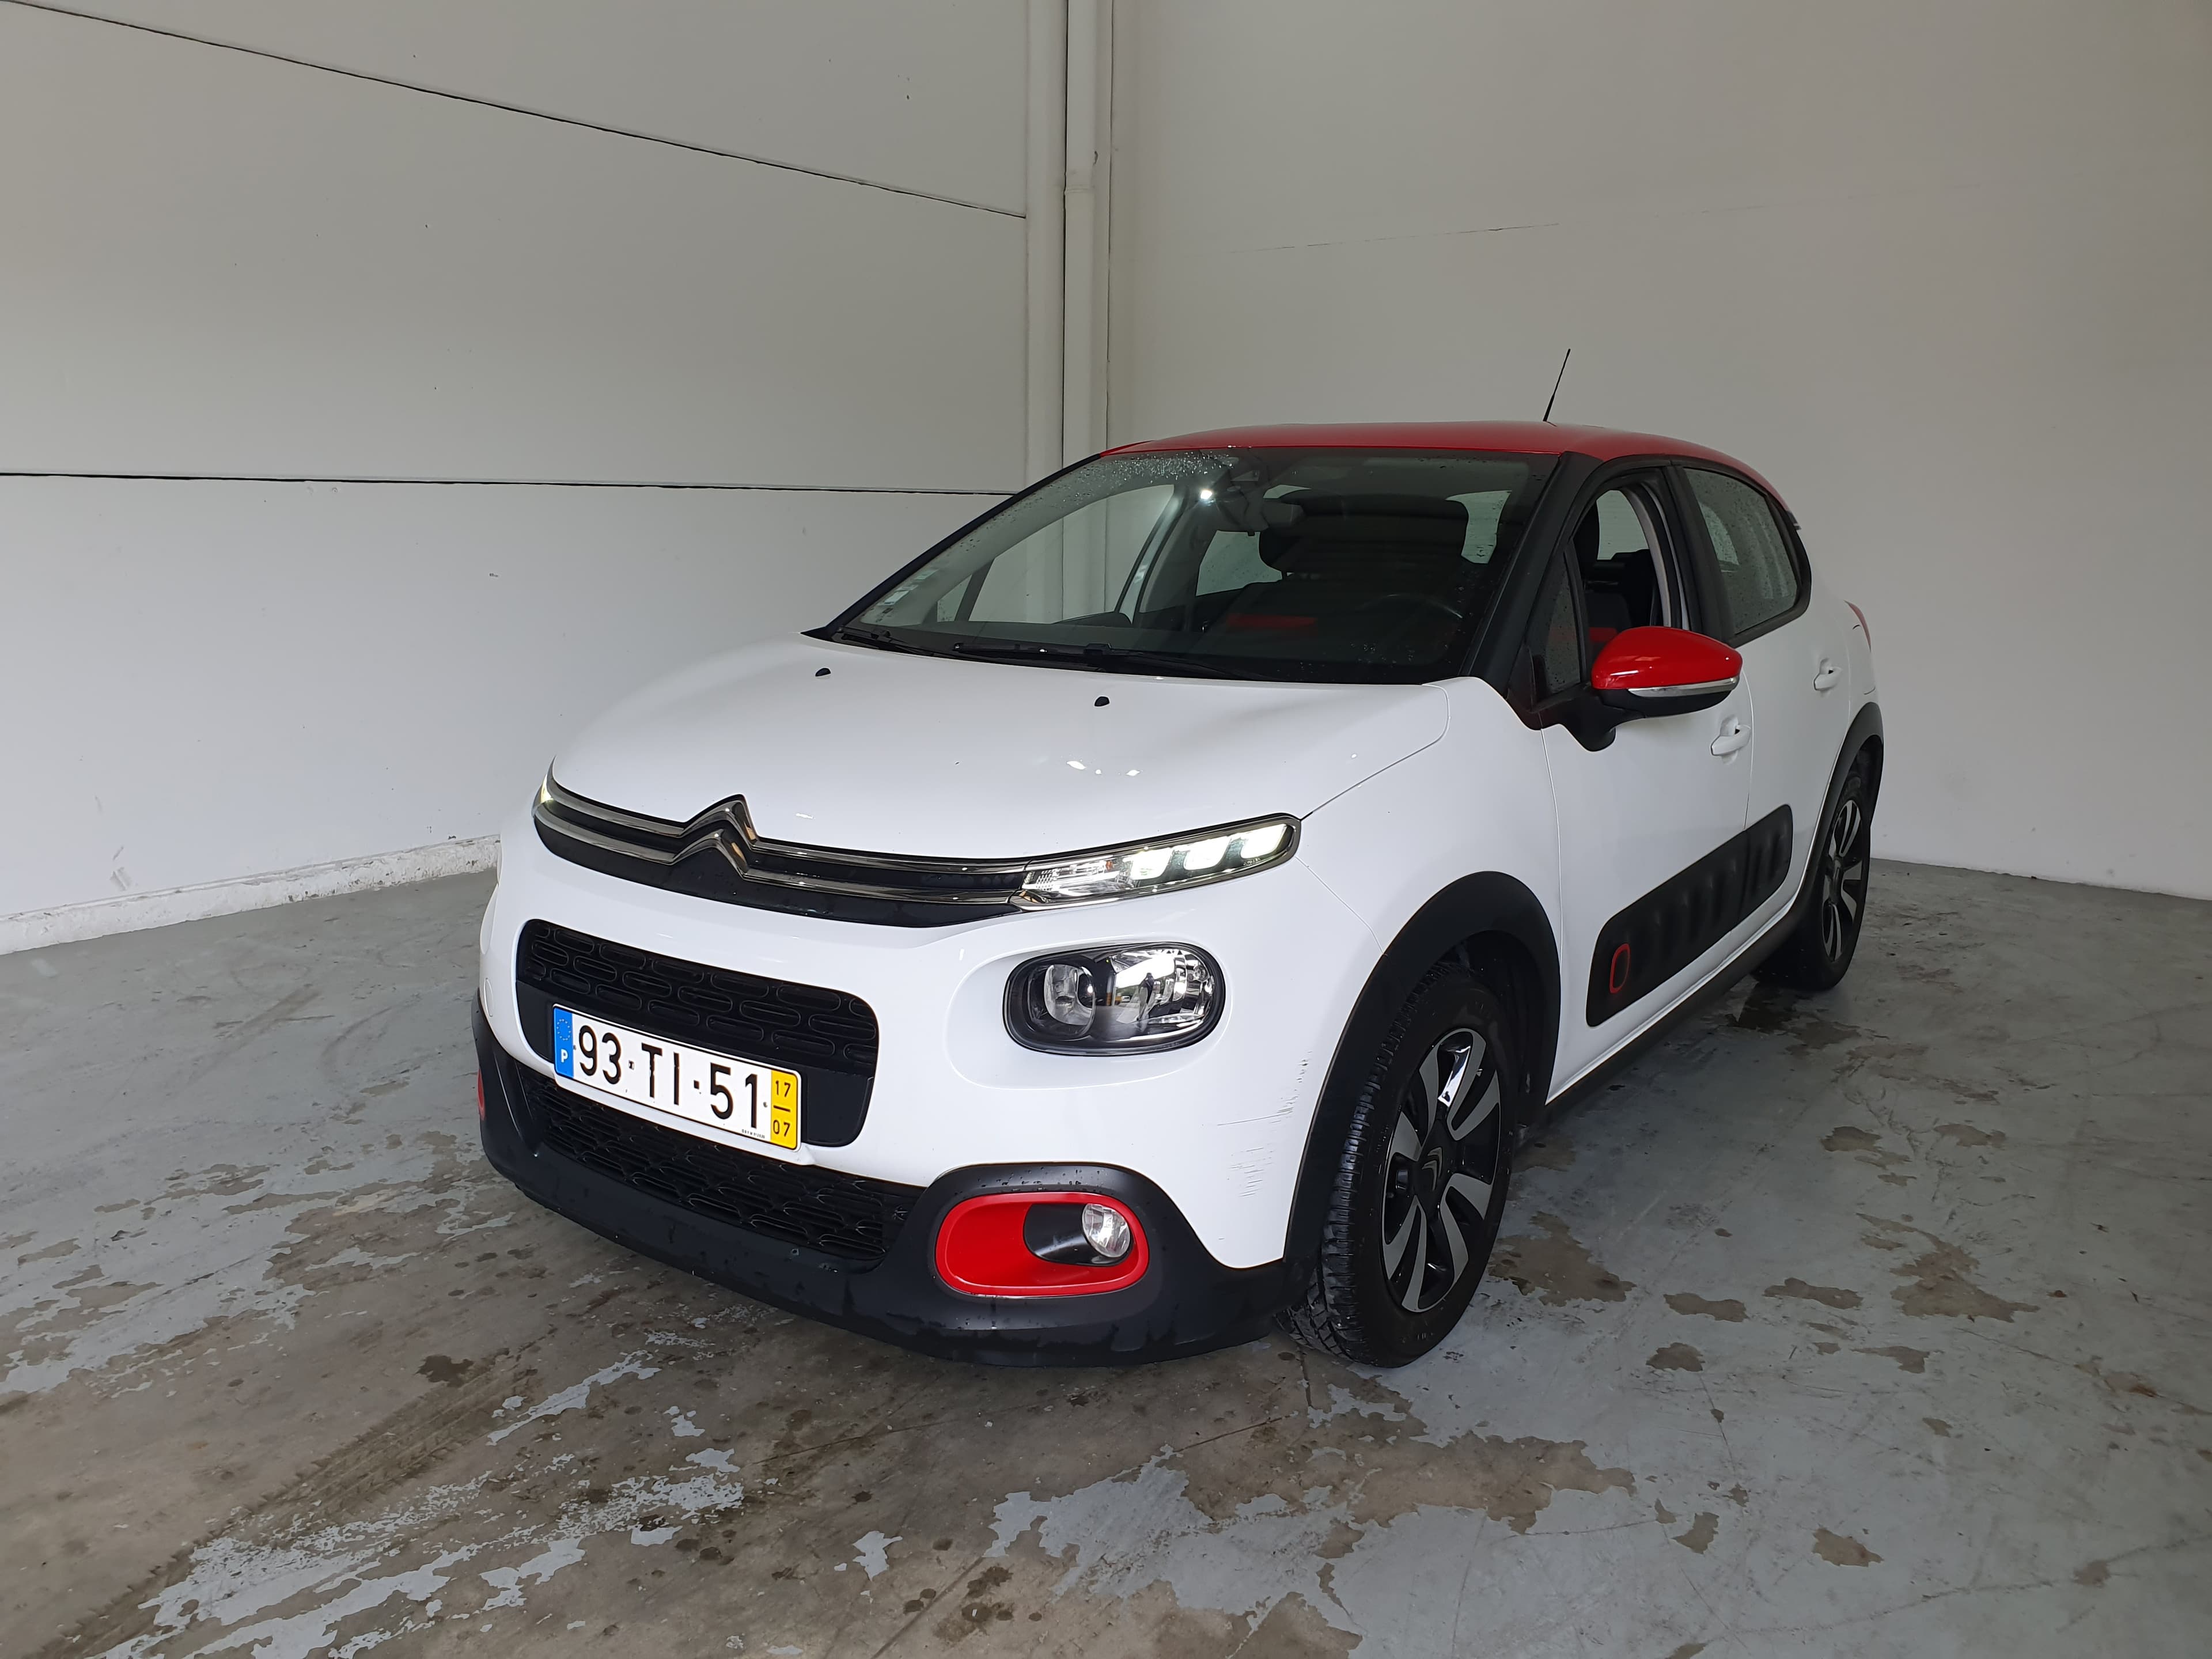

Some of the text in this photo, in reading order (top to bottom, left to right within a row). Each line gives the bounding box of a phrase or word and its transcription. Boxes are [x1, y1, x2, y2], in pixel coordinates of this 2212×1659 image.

[560, 1048, 569, 1063] P
[775, 1080, 791, 1098] 17
[772, 1119, 791, 1138] 07
